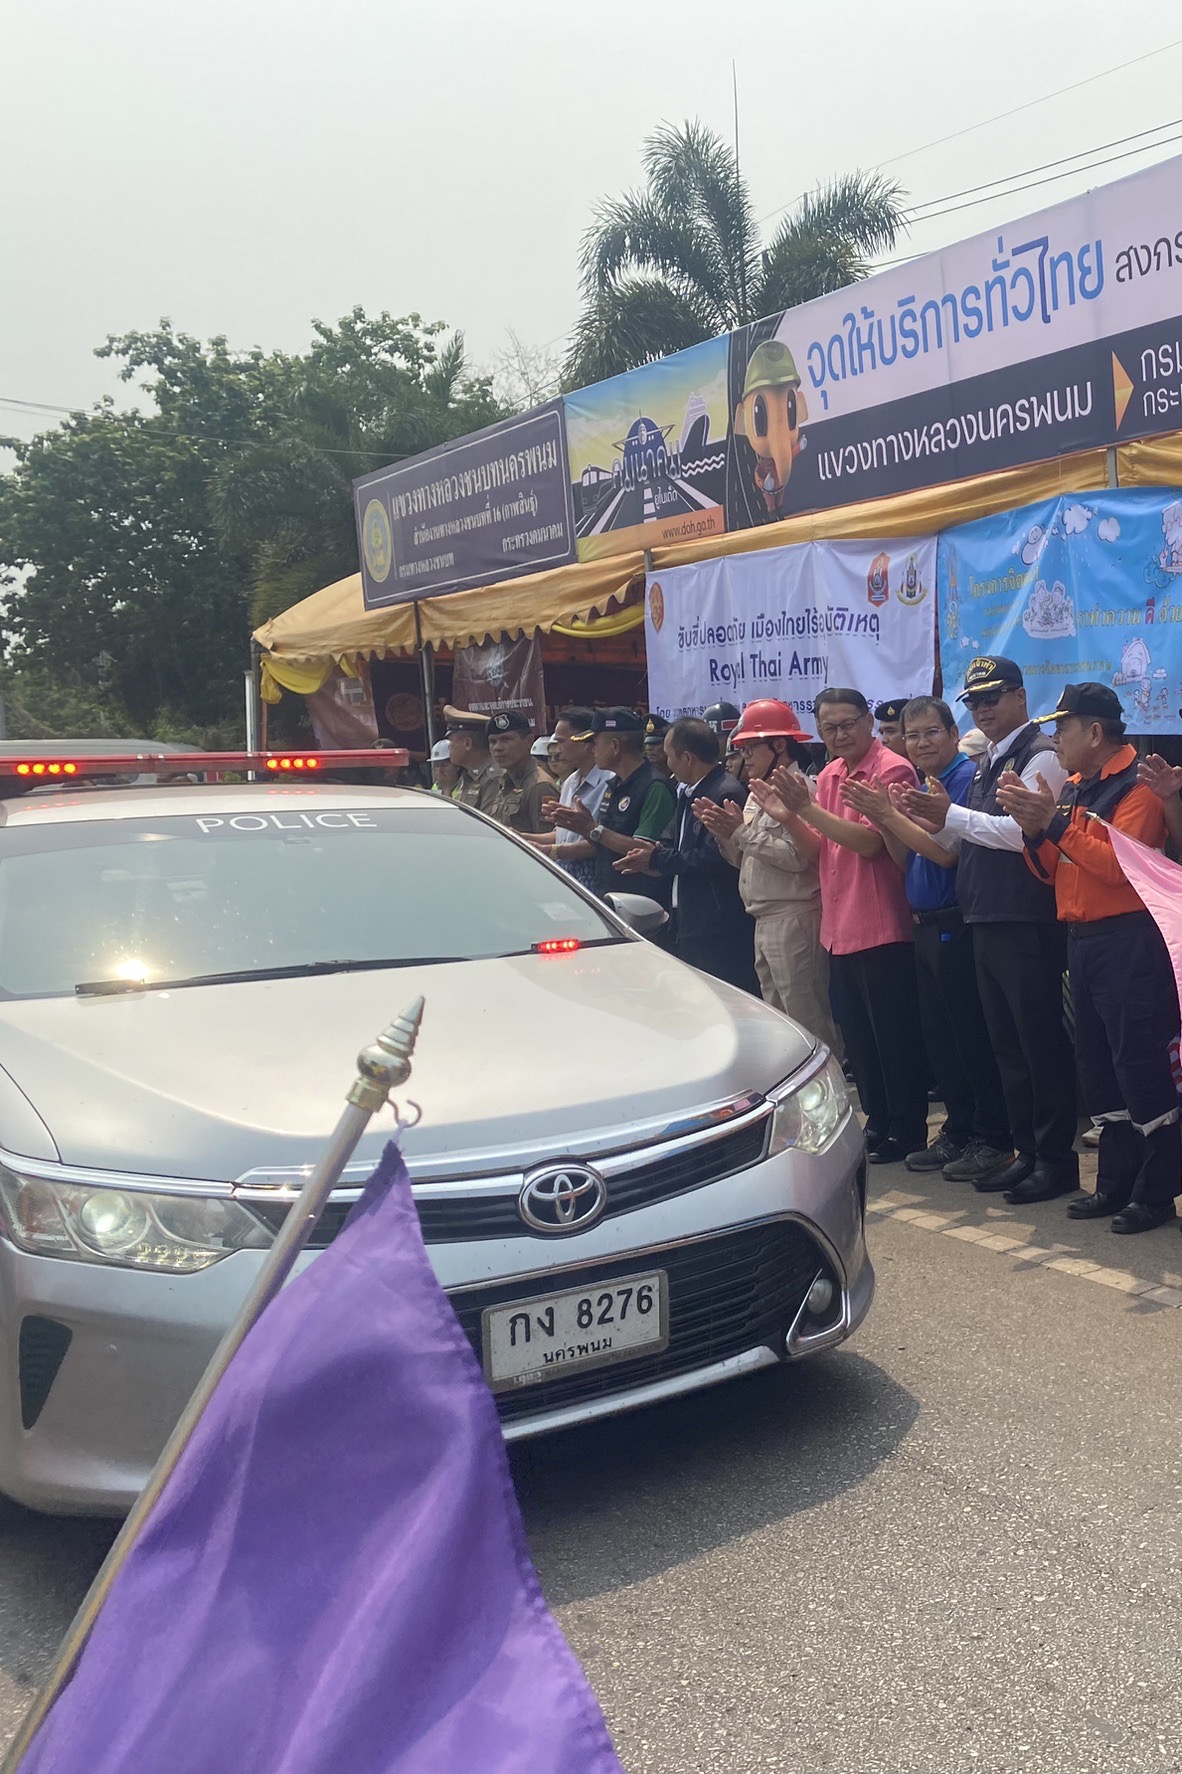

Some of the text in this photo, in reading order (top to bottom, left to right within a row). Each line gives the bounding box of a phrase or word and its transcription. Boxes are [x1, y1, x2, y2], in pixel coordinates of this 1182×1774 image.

[806, 235, 1105, 410] จุดให้บริการทั่วไทย
[817, 381, 1094, 481] แขวงทางหลวงนครพนม
[392, 439, 558, 521] แขวงทางหลวงชนบทนครพนม
[493, 507, 501, 522] 16
[662, 517, 715, 539] www.doh.go.th
[709, 650, 829, 688] Royal Thai Army
[195, 813, 378, 834] POLICE
[509, 1285, 654, 1346] กง 8276
[543, 1337, 612, 1363] นครพนม
